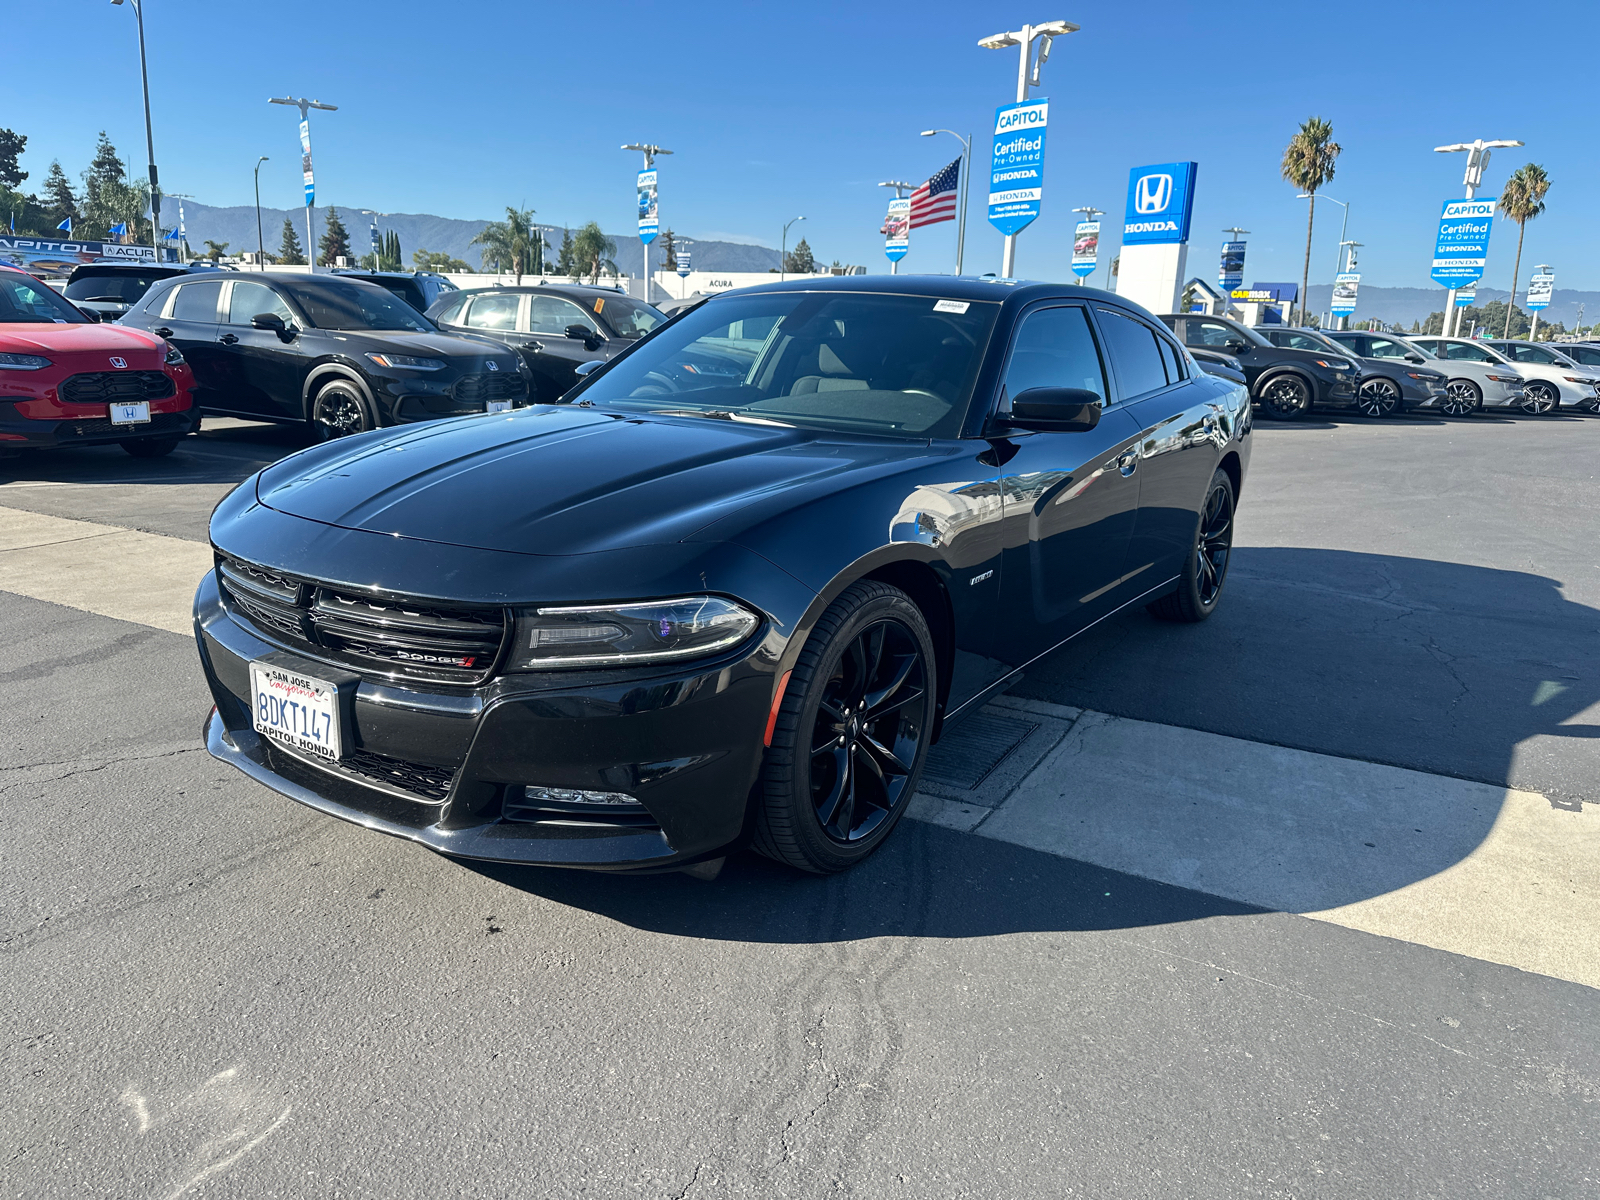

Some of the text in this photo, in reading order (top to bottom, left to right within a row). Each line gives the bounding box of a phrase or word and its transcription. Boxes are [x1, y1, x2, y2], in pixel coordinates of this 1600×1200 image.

[999, 110, 1045, 128] CAPITOL
[994, 135, 1042, 156] Certified
[993, 151, 1040, 165] Pre-Owned
[1000, 170, 1038, 181] HONDA
[999, 191, 1035, 201] HONDA
[890, 202, 909, 210] CAPITOL
[1447, 205, 1492, 215] CAPITOL
[1124, 221, 1179, 234] HONDA
[1440, 222, 1488, 234] Certified
[397, 650, 465, 664] DODGE
[272, 671, 311, 690] SAN JOSE
[269, 679, 321, 702] California
[259, 692, 331, 745] 8DKT147
[256, 723, 336, 759] CAPITOL HONDA
